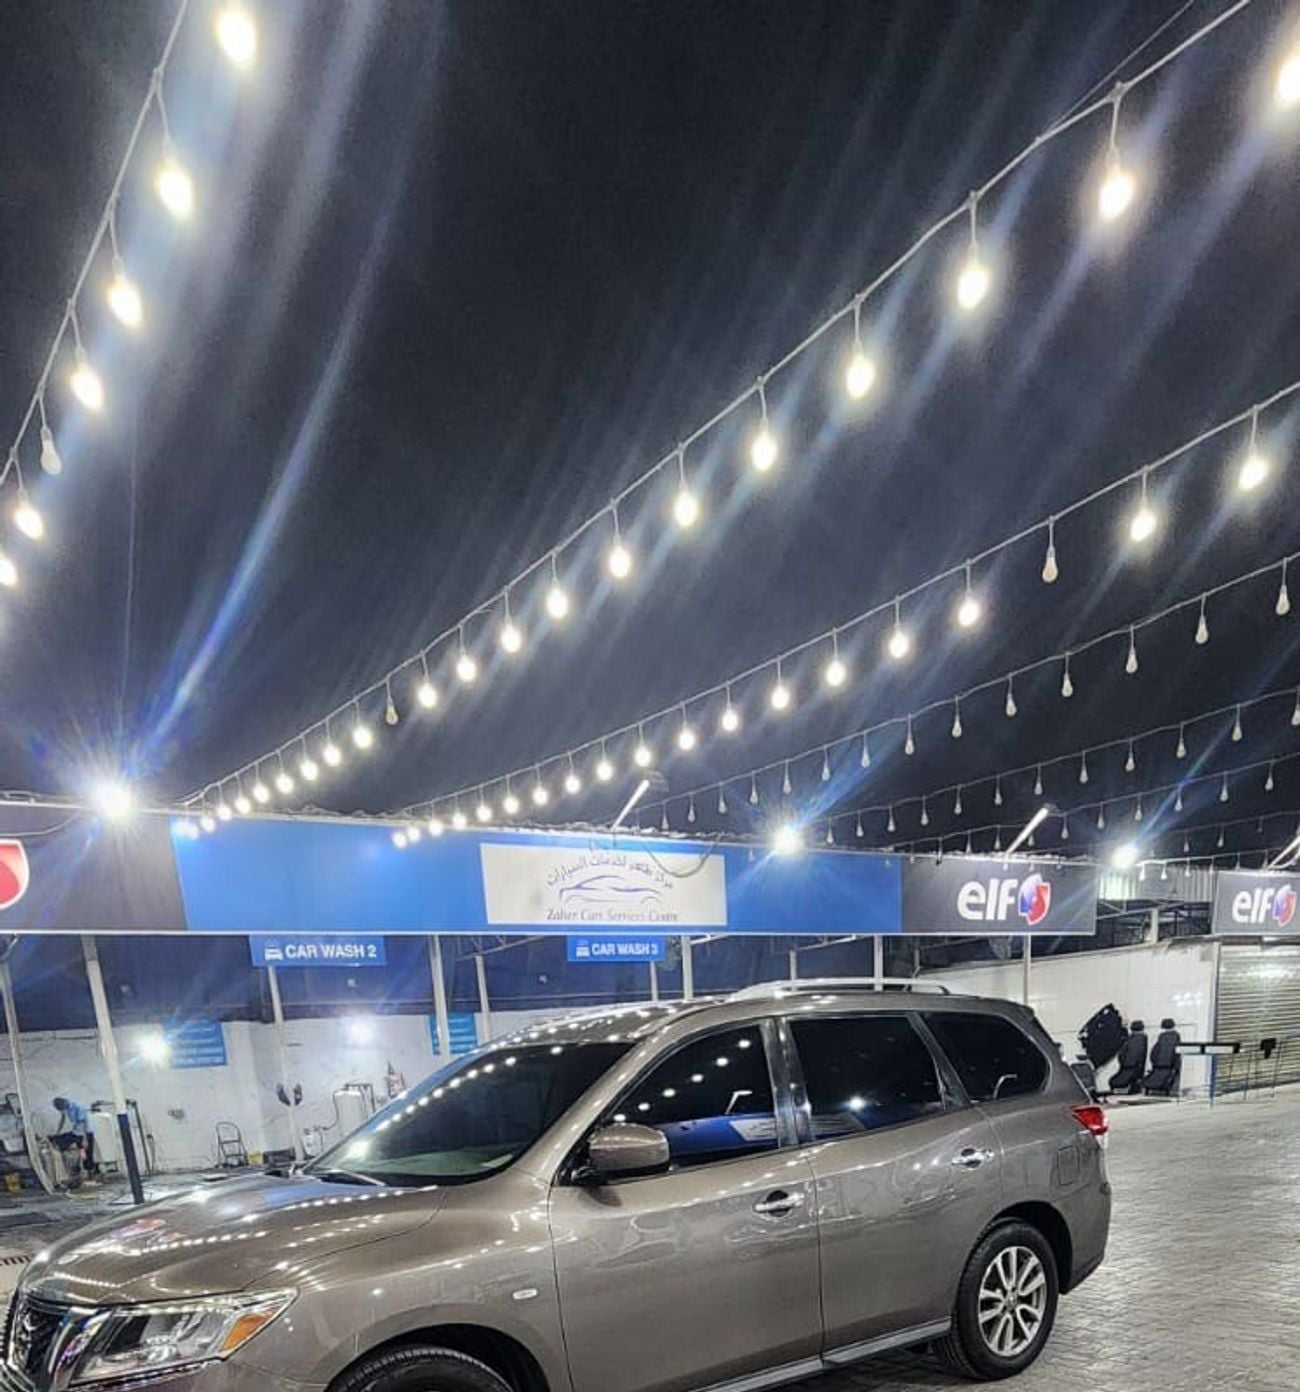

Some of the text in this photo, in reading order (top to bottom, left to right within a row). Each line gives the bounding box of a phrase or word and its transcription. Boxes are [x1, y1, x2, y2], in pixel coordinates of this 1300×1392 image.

[544, 855, 589, 887] السيارات
[957, 877, 1019, 921] elf
[1232, 886, 1275, 923] elf
[285, 943, 377, 958] CAR WASH 2
[591, 943, 659, 956] CAR WASH 3
